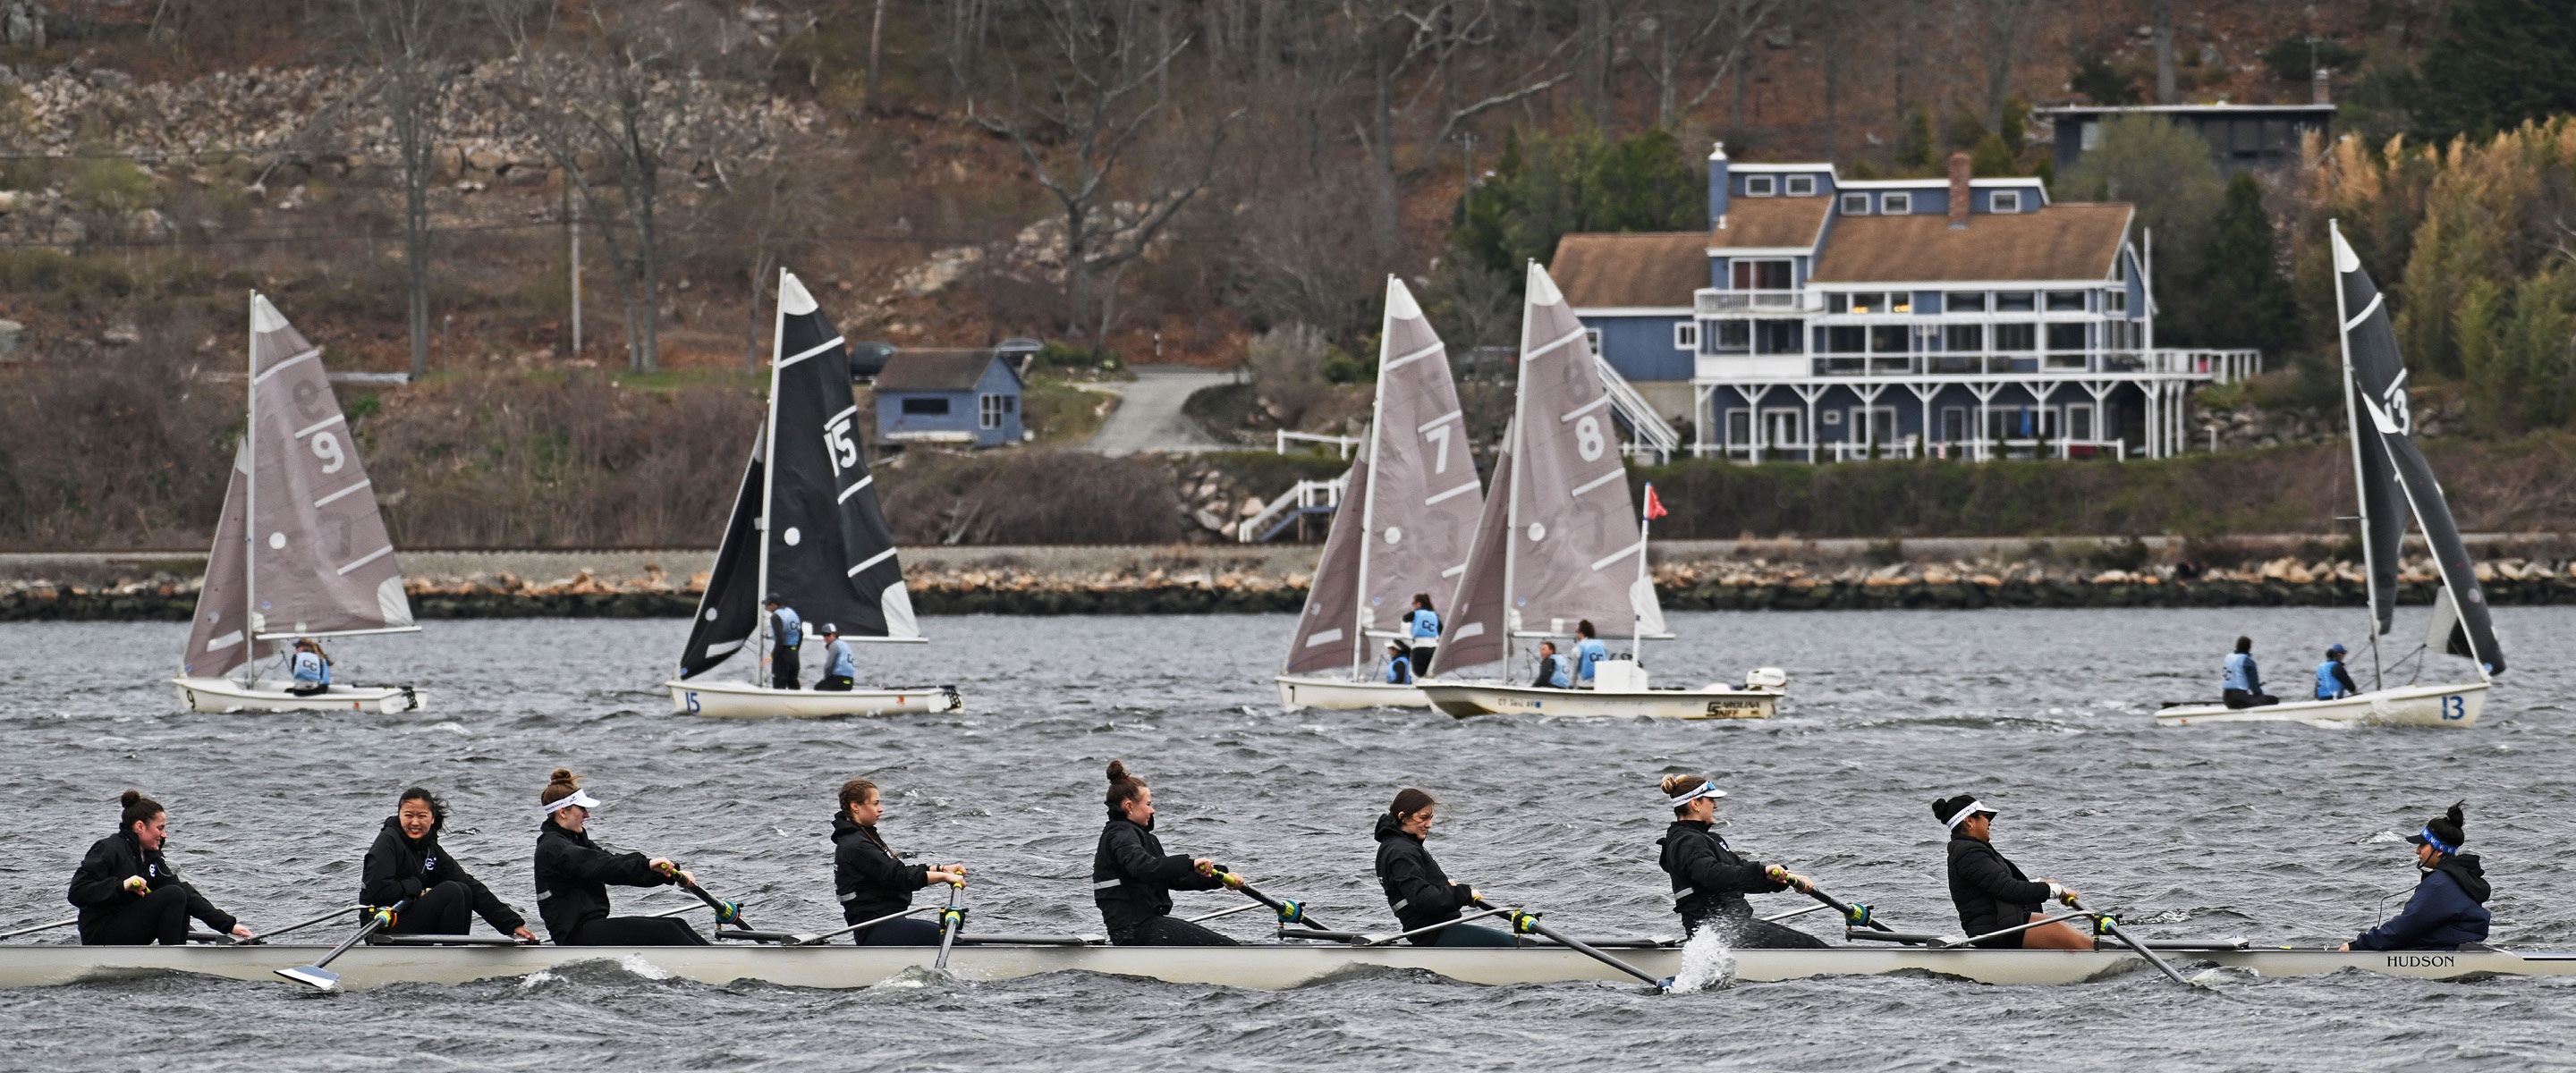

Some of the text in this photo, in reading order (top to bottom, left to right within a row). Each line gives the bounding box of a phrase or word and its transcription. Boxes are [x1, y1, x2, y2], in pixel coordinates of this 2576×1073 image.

[823, 418, 857, 477] 15
[1426, 424, 1451, 475] 7
[1575, 416, 1605, 462] 8
[311, 431, 344, 474] 9
[1422, 620, 1435, 632] CC
[186, 689, 196, 709] 9
[685, 691, 700, 714] 15
[1288, 684, 1295, 703] 7
[2442, 695, 2465, 720] 13
[2387, 956, 2454, 967] HUDSON
